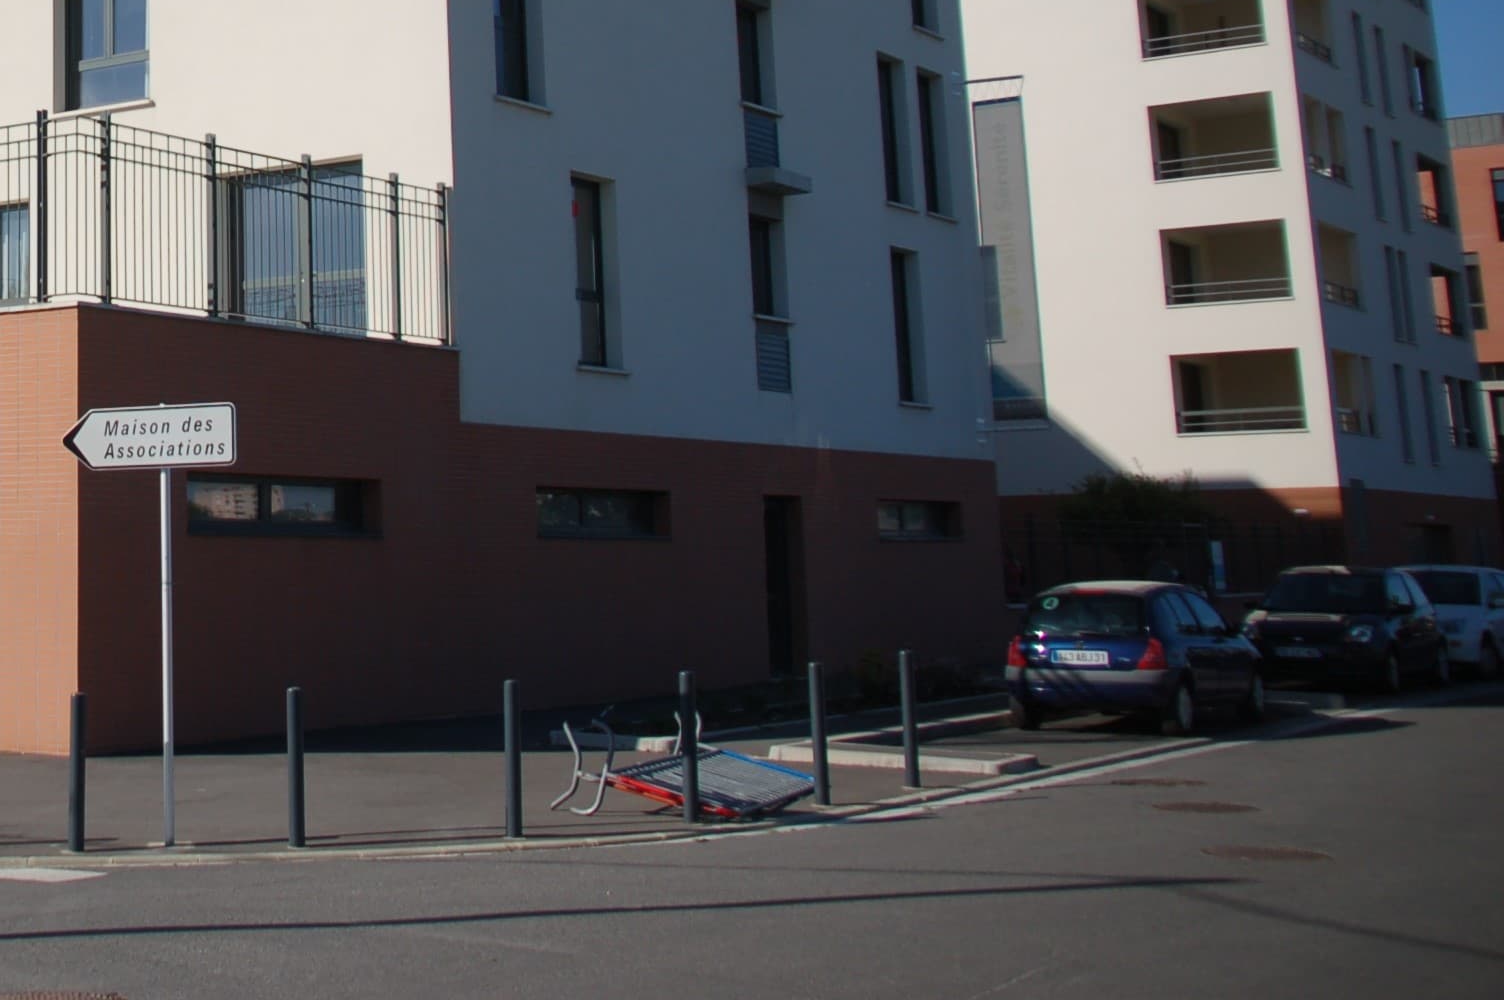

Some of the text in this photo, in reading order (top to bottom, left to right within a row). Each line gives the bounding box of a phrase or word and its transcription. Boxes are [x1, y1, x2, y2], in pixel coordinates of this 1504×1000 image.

[103, 416, 213, 437] Maison des
[103, 440, 225, 460] Associations
